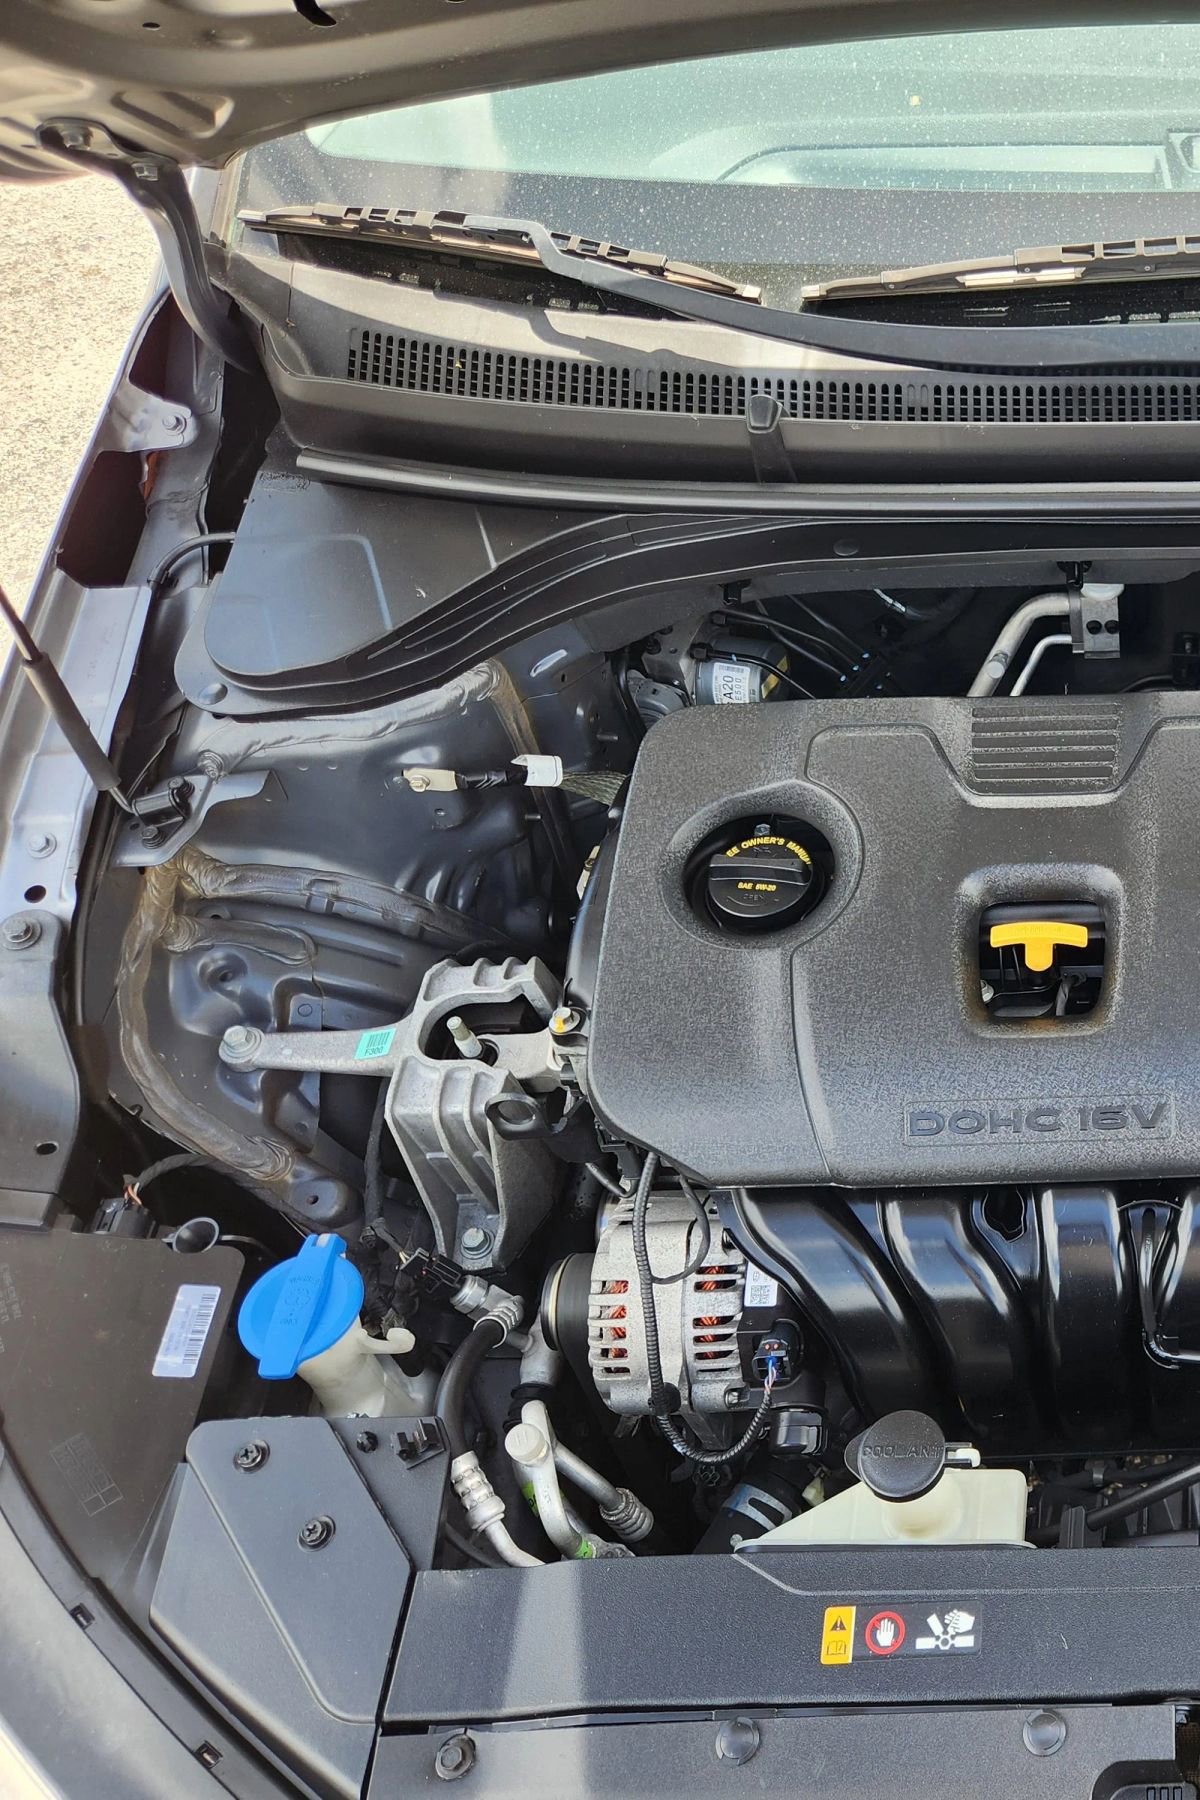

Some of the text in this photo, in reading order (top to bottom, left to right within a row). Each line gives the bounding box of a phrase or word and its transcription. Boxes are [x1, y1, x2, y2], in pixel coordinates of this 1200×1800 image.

[726, 846, 741, 858] EE
[741, 836, 785, 849] OWNER'S
[738, 882, 777, 892] SAE 5W-20
[908, 1102, 1168, 1137] DOHC 16V
[863, 1445, 944, 1459] COOLANT
